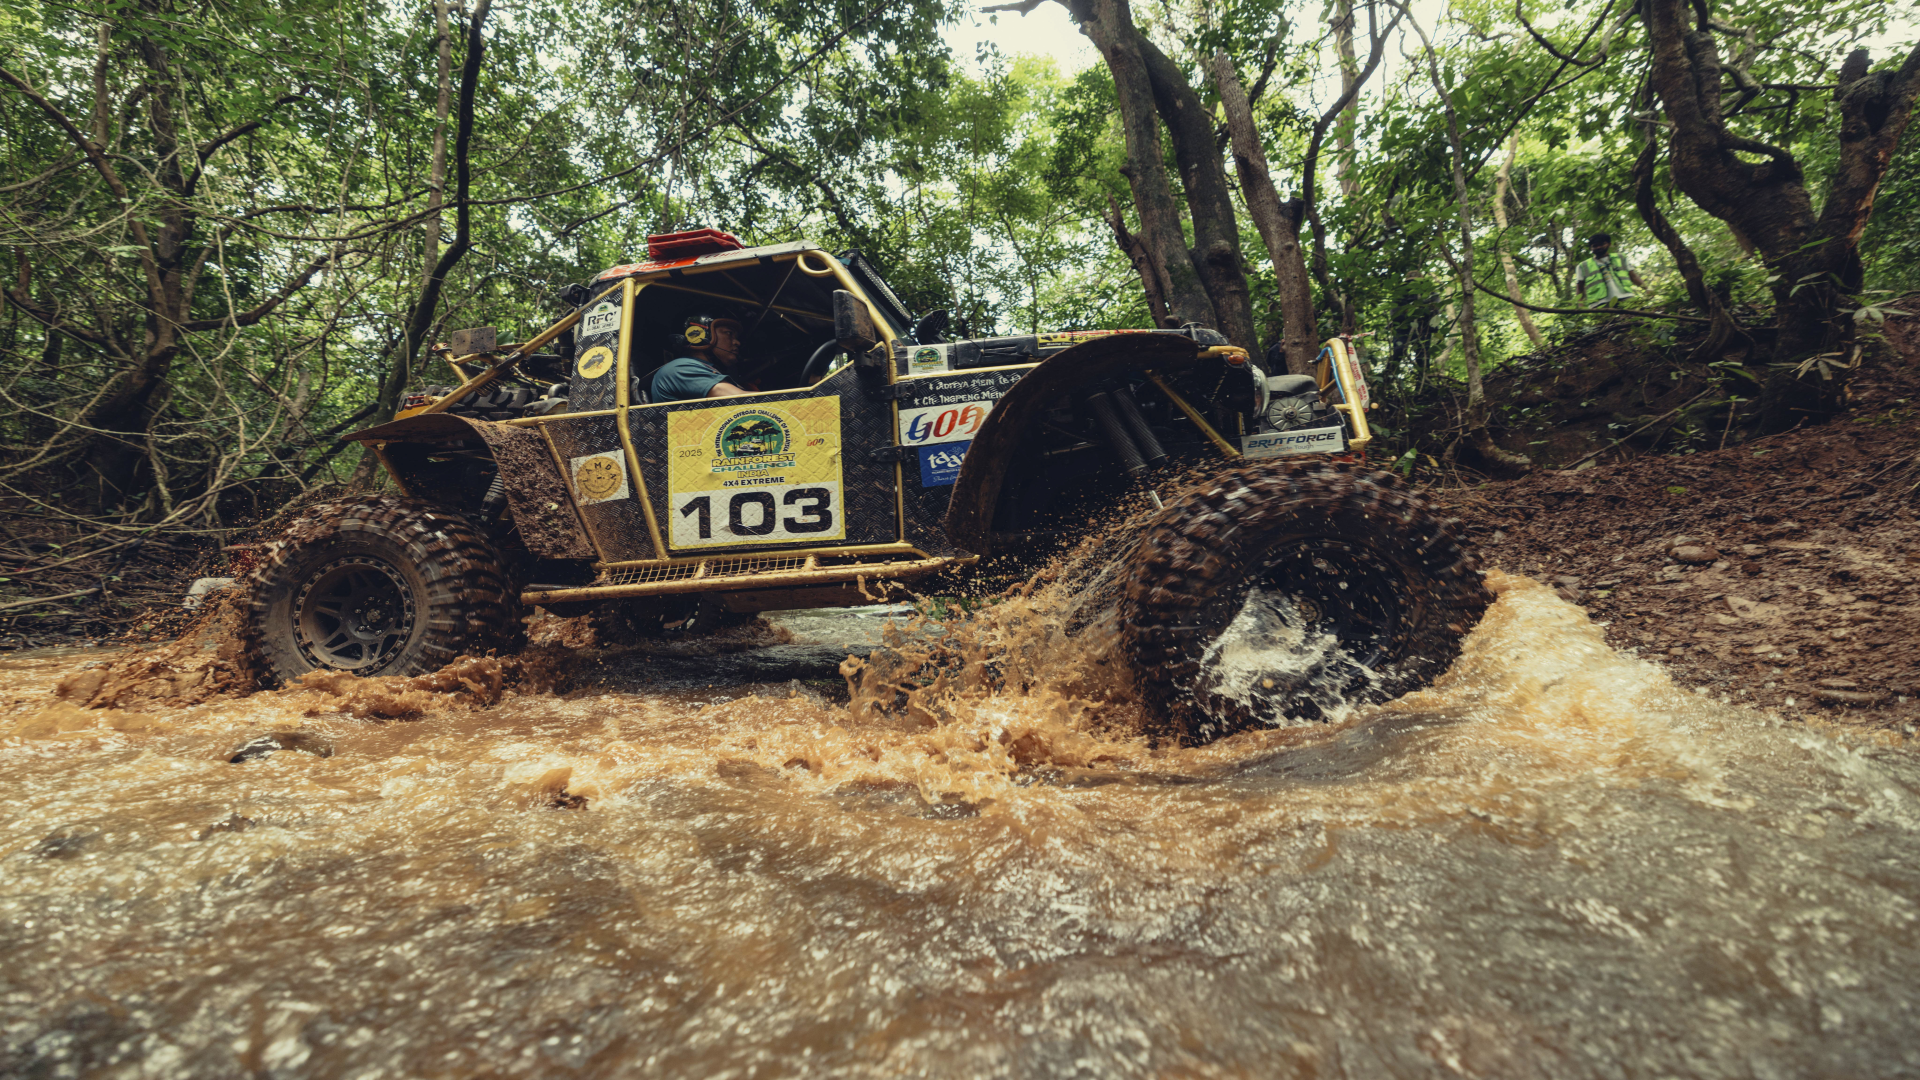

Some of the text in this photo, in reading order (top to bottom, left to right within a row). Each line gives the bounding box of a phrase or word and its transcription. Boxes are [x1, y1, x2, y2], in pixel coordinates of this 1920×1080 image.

[715, 417, 734, 449] INTERNATIONAL
[733, 409, 757, 419] OFFROAD
[757, 409, 784, 424] CHALLENGE
[679, 449, 703, 458] 2025
[711, 452, 796, 468] RAINFOREST
[711, 461, 796, 473] CHALLENGE
[737, 469, 769, 478] INDIA
[741, 476, 785, 486] EXTREME
[679, 487, 833, 539] 103
